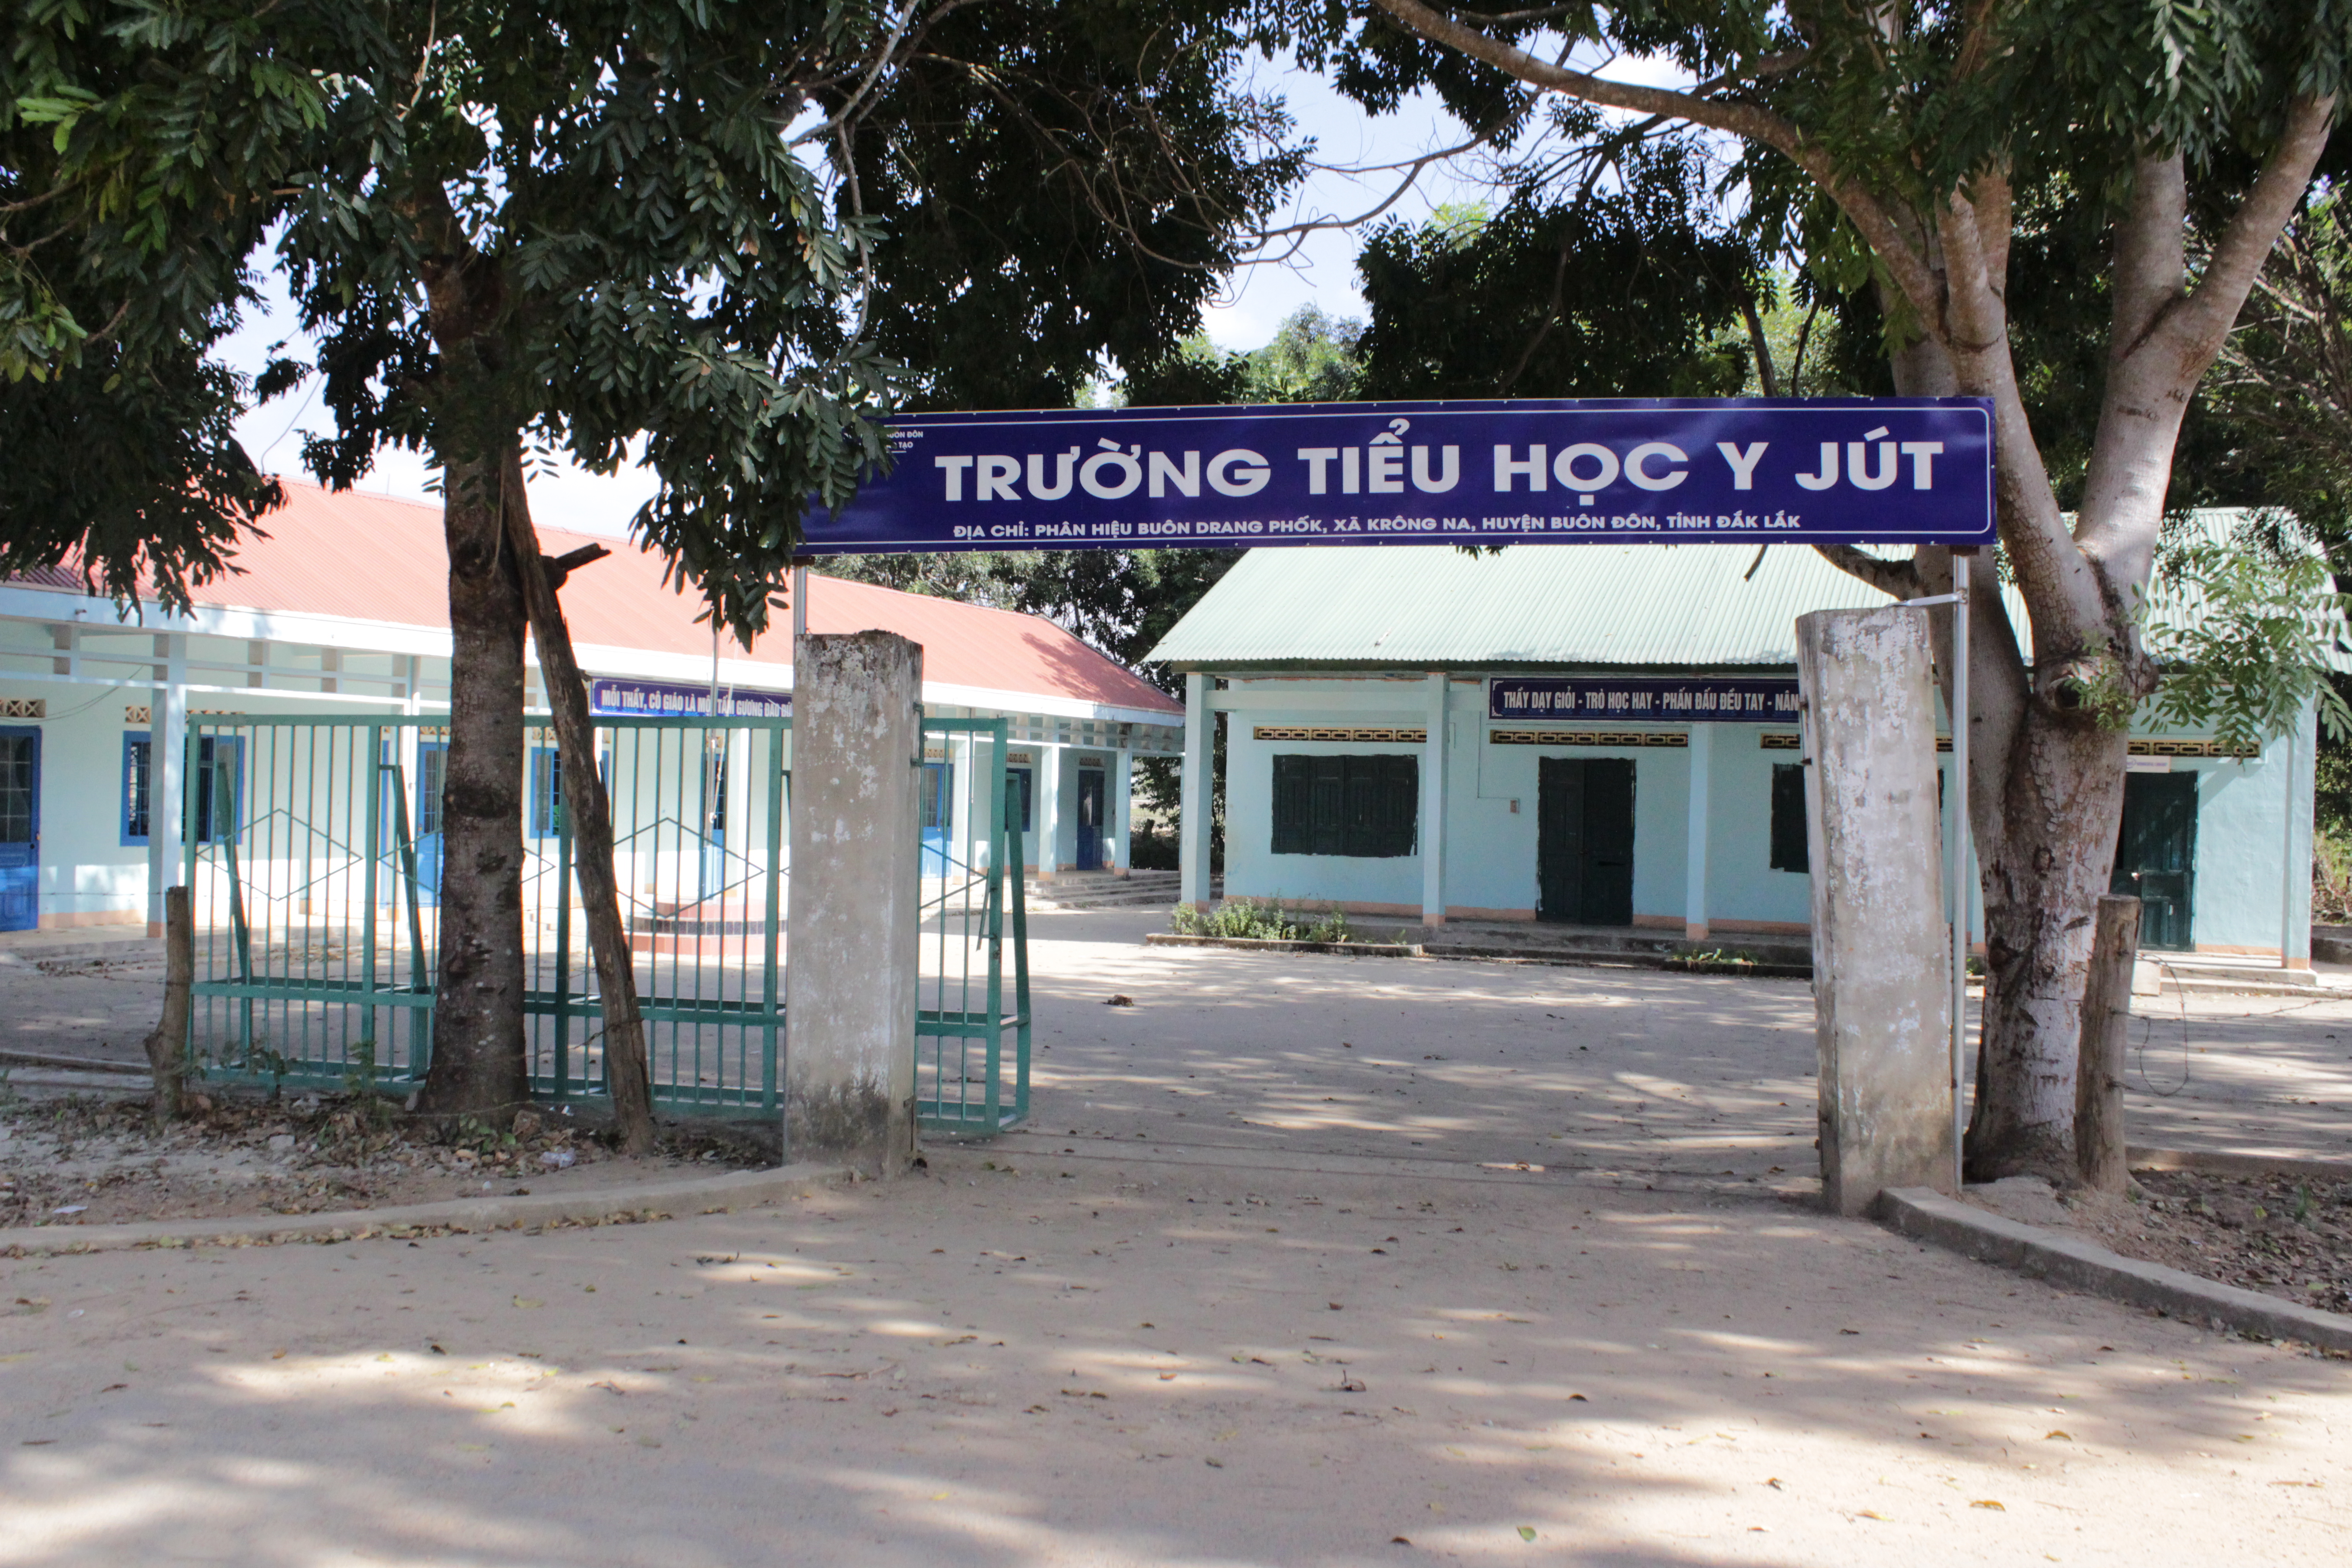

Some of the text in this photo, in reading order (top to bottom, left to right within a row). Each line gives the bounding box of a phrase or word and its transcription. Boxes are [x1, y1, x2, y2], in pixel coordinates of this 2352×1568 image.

[898, 441, 913, 450] TẠO
[935, 418, 1944, 505] TRƯỜNG TIỂU HỌC Y JÚT
[953, 510, 1801, 540] ĐỊA CHỈ: PHÂN HIỆU BUÔN DRANG PHỐK, XÃ KRÔNG NA, HUYỆN BUÔN ĐÔN, TỈNH ĐẮK LẮK
[601, 684, 620, 707] MỖI
[649, 691, 661, 710] CÔ
[663, 692, 684, 711] GIÁO
[685, 693, 696, 712] LÀ
[697, 695, 710, 716] MỘ
[736, 699, 763, 716] GƯƠNG
[1531, 692, 1552, 712] DẠY
[1554, 686, 1575, 709] GIỎI
[1585, 688, 1605, 709] TRÒ
[1608, 692, 1629, 713] HỌC
[1632, 692, 1653, 709] HAY
[1663, 687, 1692, 710] PHẤN
[1695, 687, 1717, 710] ĐẤU
[1744, 693, 1765, 711] TAY
